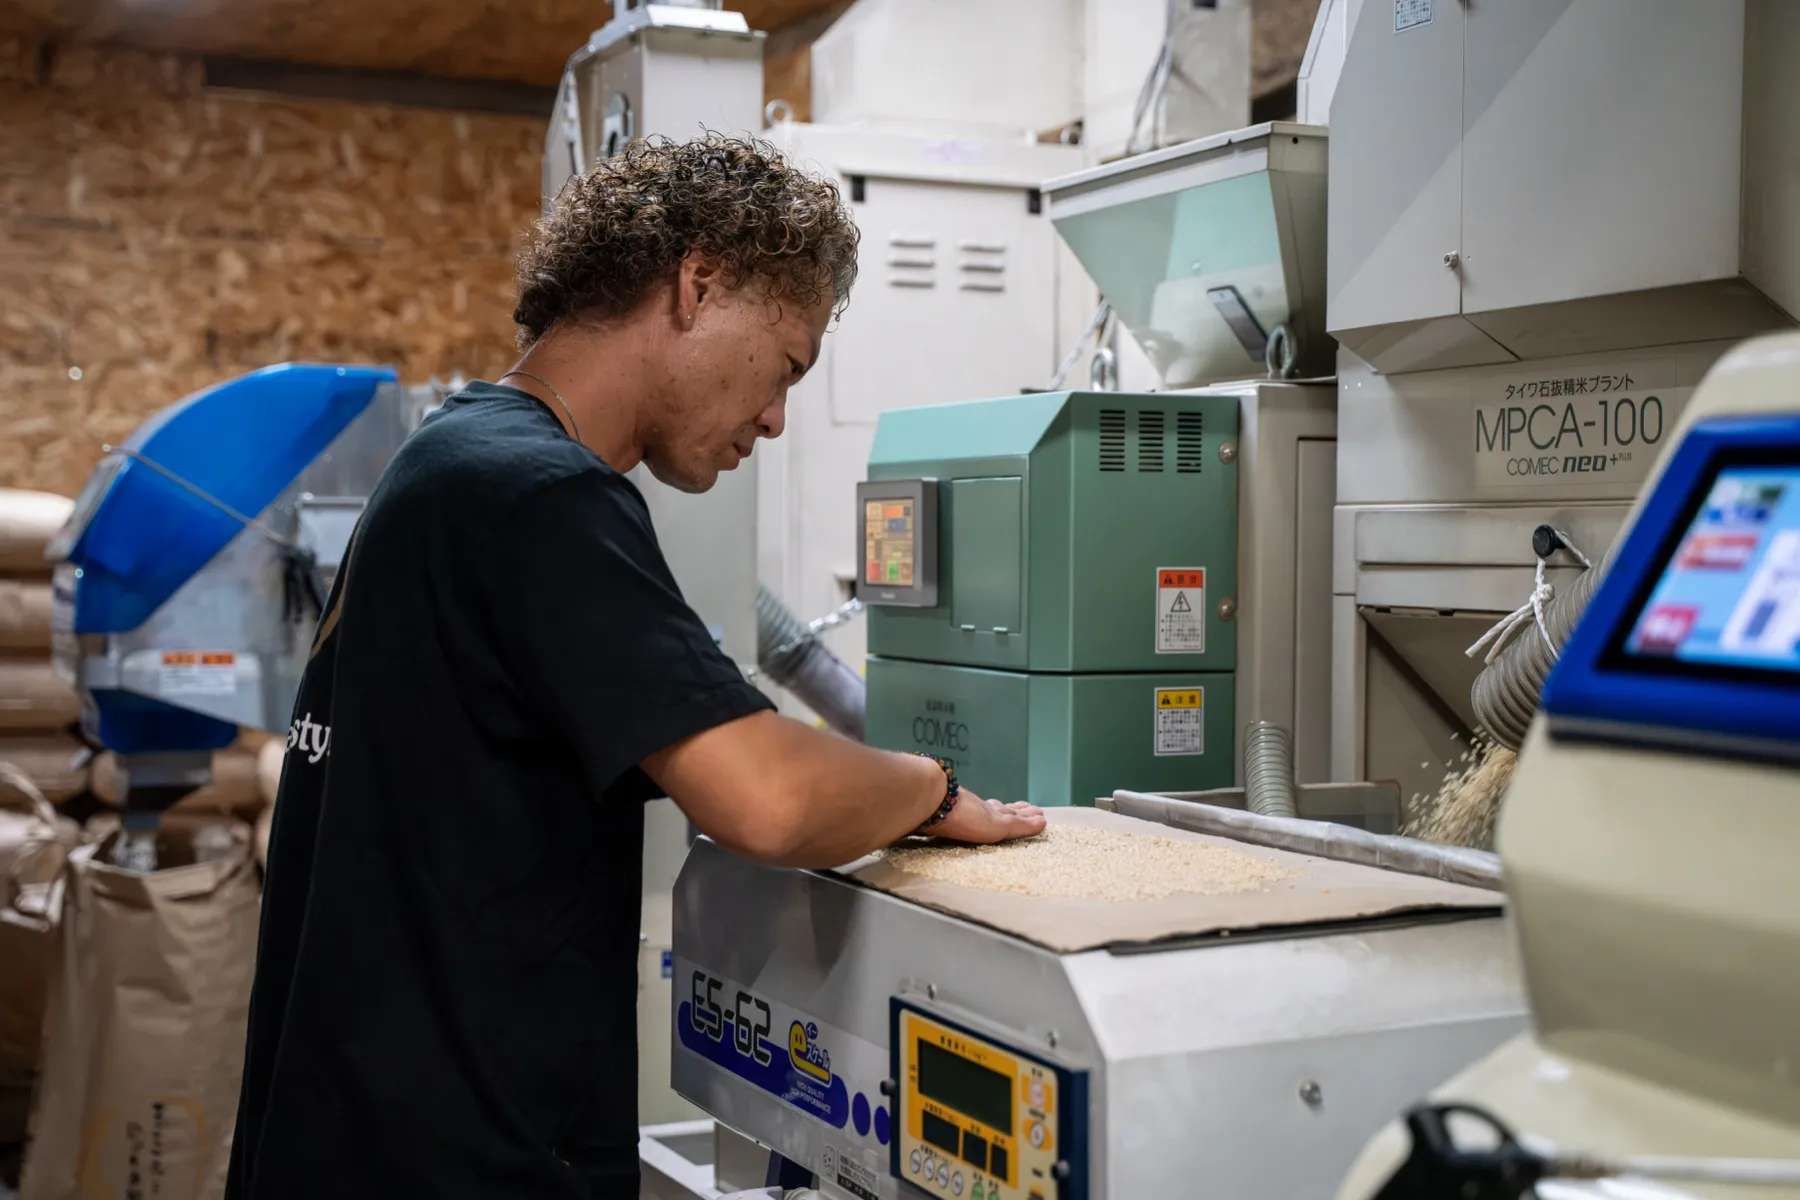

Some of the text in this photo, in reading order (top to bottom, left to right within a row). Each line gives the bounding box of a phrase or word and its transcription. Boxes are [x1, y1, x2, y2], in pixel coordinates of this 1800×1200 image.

[1505, 373, 1635, 400] タイワ石抜精米プラント
[1476, 396, 1663, 453] MPCA-100
[1506, 456, 1559, 476] COMEC
[1562, 455, 1607, 473] neo
[912, 716, 970, 752] COMEC
[692, 969, 771, 1065] ES-62
